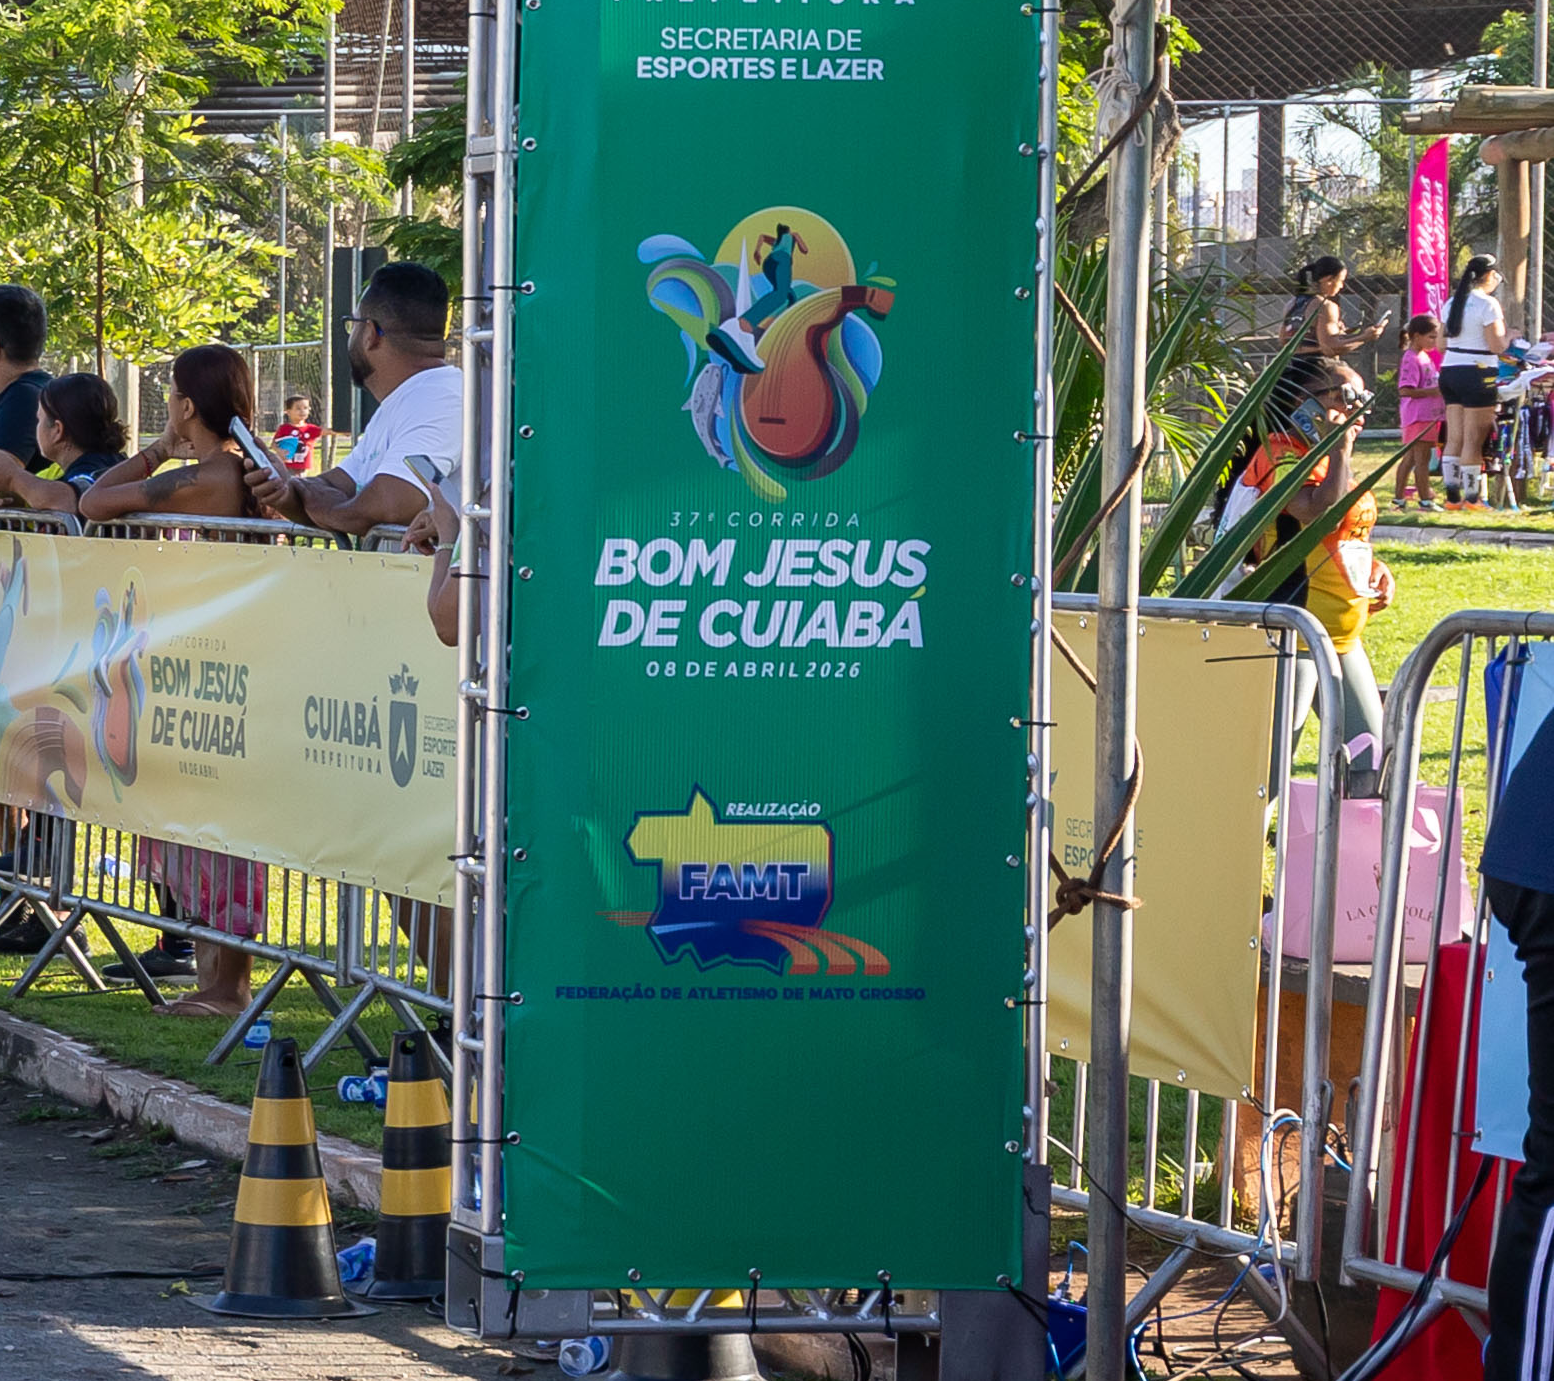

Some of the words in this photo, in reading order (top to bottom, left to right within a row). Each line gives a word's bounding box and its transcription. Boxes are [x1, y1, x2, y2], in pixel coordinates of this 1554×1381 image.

[660, 27, 821, 52] SECRETARIA
[826, 29, 861, 52] DE
[636, 56, 775, 80] ESPORTES
[781, 57, 796, 80] E
[802, 58, 884, 81] LAZER
[727, 511, 861, 528] CORRIDA
[594, 538, 737, 587] BOM
[743, 538, 932, 588] JESUS
[597, 599, 687, 648] DE
[698, 585, 926, 649] CUIABÁ
[151, 655, 190, 698] BOM
[194, 660, 249, 706] JESUS
[646, 661, 677, 678] 08
[685, 662, 717, 678] DE
[725, 662, 801, 679] ABRIL
[805, 662, 862, 679] 2026
[151, 706, 177, 746] DE
[179, 704, 246, 759] CUIABÁ
[304, 695, 382, 750] CUIABÁ
[423, 735, 456, 757] ESPORTE
[305, 748, 382, 776] PREFEITURA
[725, 801, 821, 822] REALIZAÇÃO
[679, 863, 811, 901] FAMT
[555, 982, 656, 1001] FEDERAÇÃO
[660, 986, 682, 1000] DE
[688, 985, 777, 1000] ATLETISMO
[782, 985, 804, 1000] DE
[809, 985, 855, 1000] MATO
[859, 985, 926, 1000] GROSSO
